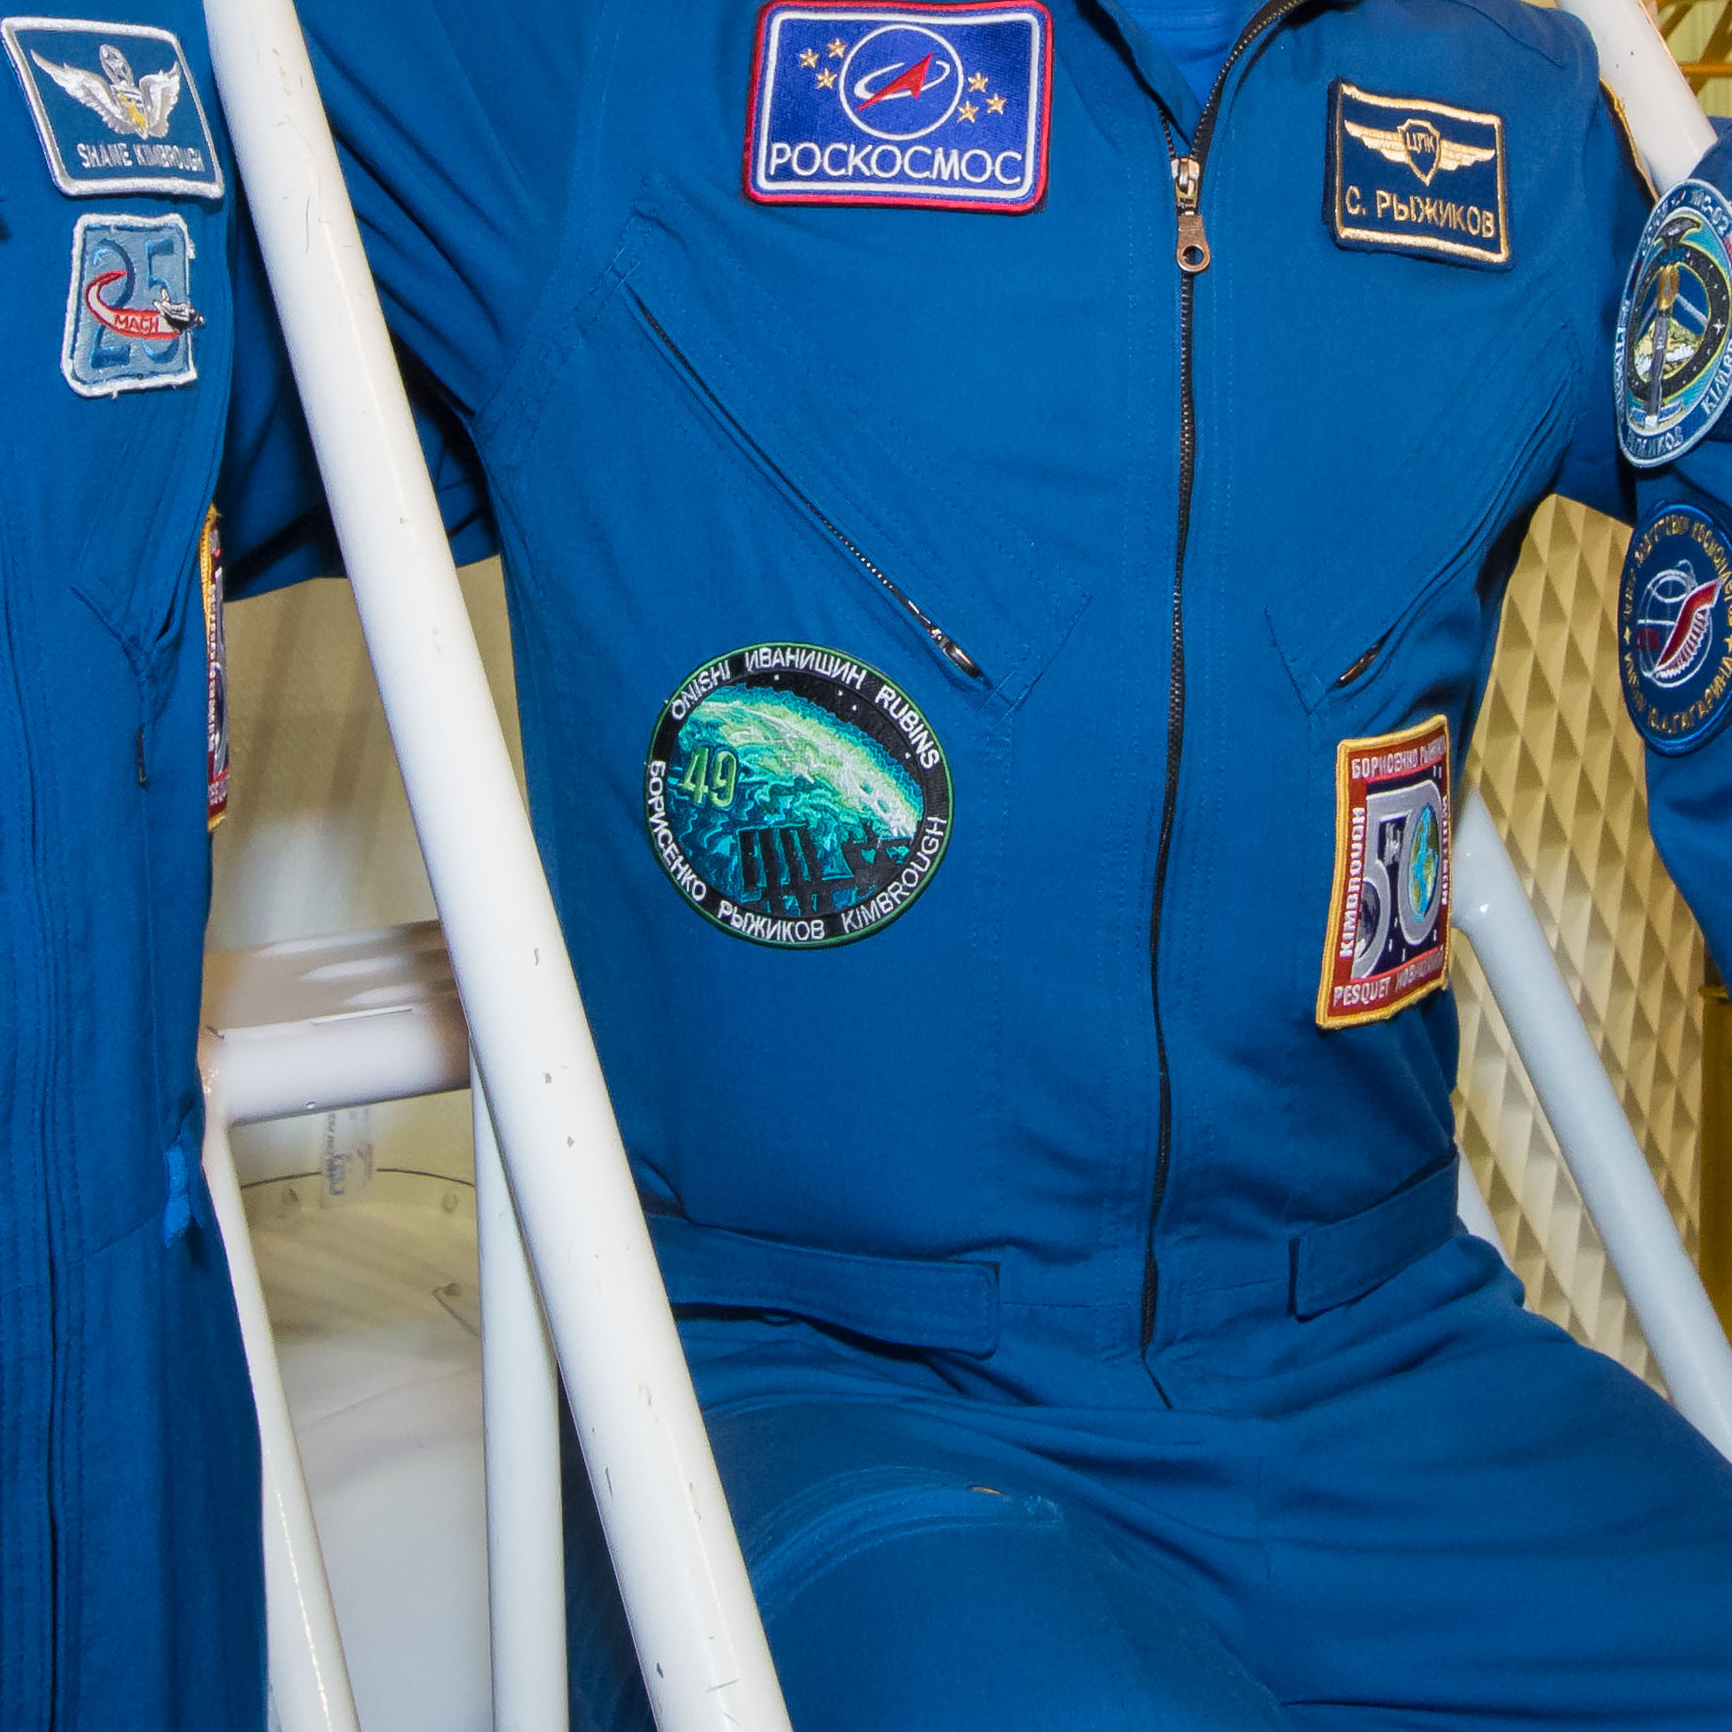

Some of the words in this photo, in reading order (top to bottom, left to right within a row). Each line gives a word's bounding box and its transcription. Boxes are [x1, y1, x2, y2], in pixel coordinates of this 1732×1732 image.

[77, 142, 133, 169] SHANE
[135, 144, 206, 173] KIMBROUGH
[770, 142, 1023, 185] РОСКОСМОС
[1345, 185, 1366, 216] С.
[1375, 189, 1496, 238] РЫЖИКОВ
[113, 313, 160, 332] MACH
[670, 659, 732, 721] ONISHI
[743, 647, 868, 690] ИВАНИШИН
[874, 684, 941, 771] RUBINS
[680, 746, 738, 809] 49
[647, 759, 708, 903] БОРИСЕНКО
[717, 899, 826, 943] РЫЖИКОВ
[840, 815, 949, 935] KIMBROUGH
[1338, 806, 1366, 959] KIMBROUGH
[1333, 976, 1392, 1007] PESQUET
